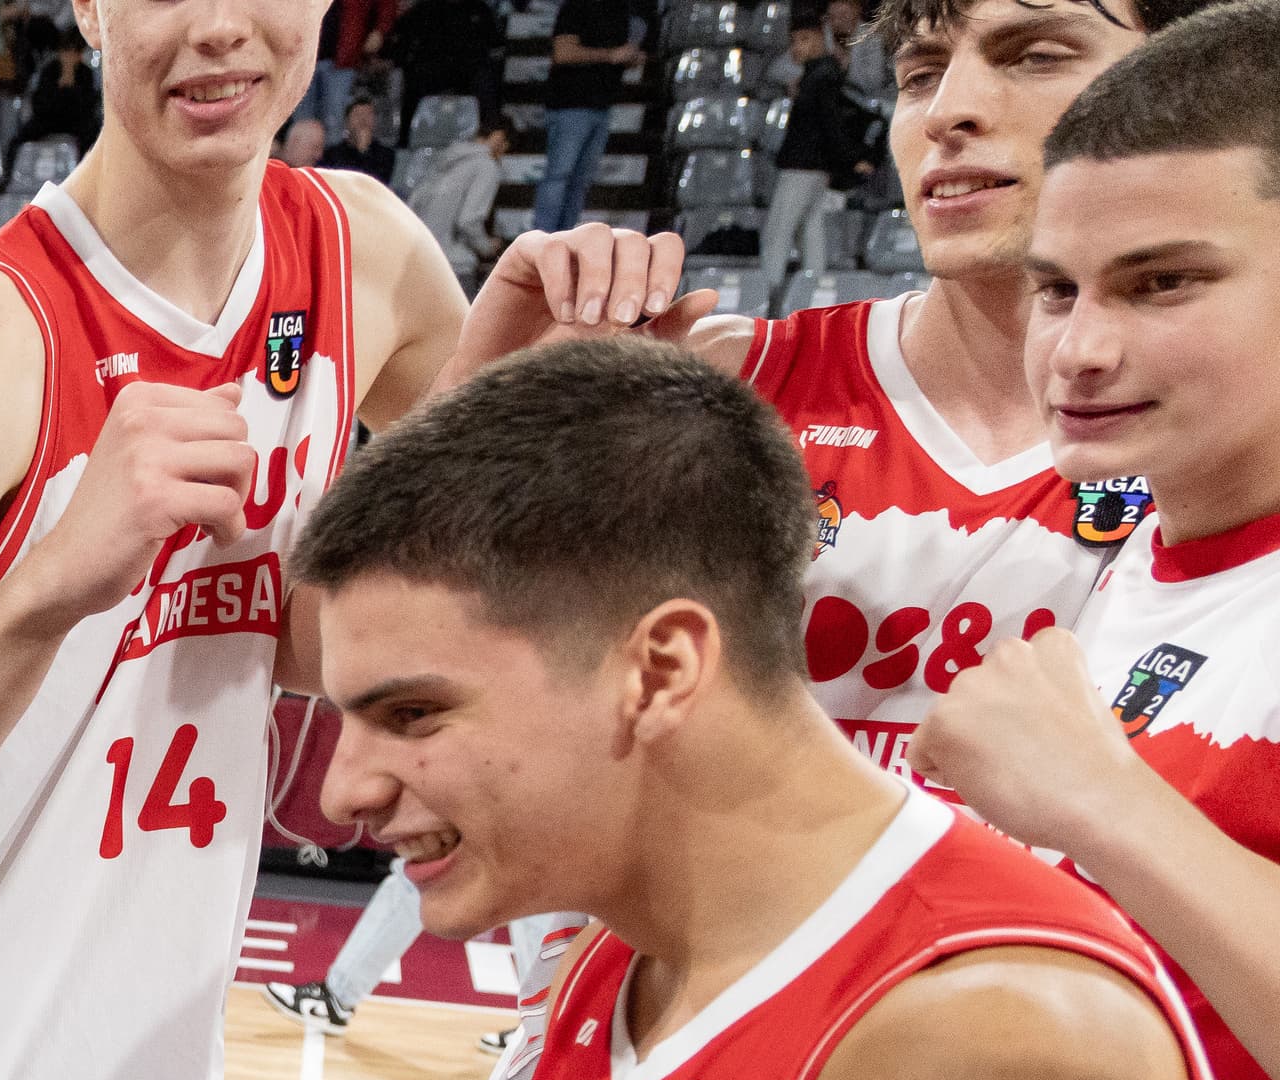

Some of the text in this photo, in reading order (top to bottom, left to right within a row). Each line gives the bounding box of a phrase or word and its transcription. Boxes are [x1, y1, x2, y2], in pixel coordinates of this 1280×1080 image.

[268, 316, 303, 337] LIGA
[1138, 652, 1192, 682] LIGA
[100, 723, 227, 859] 14
